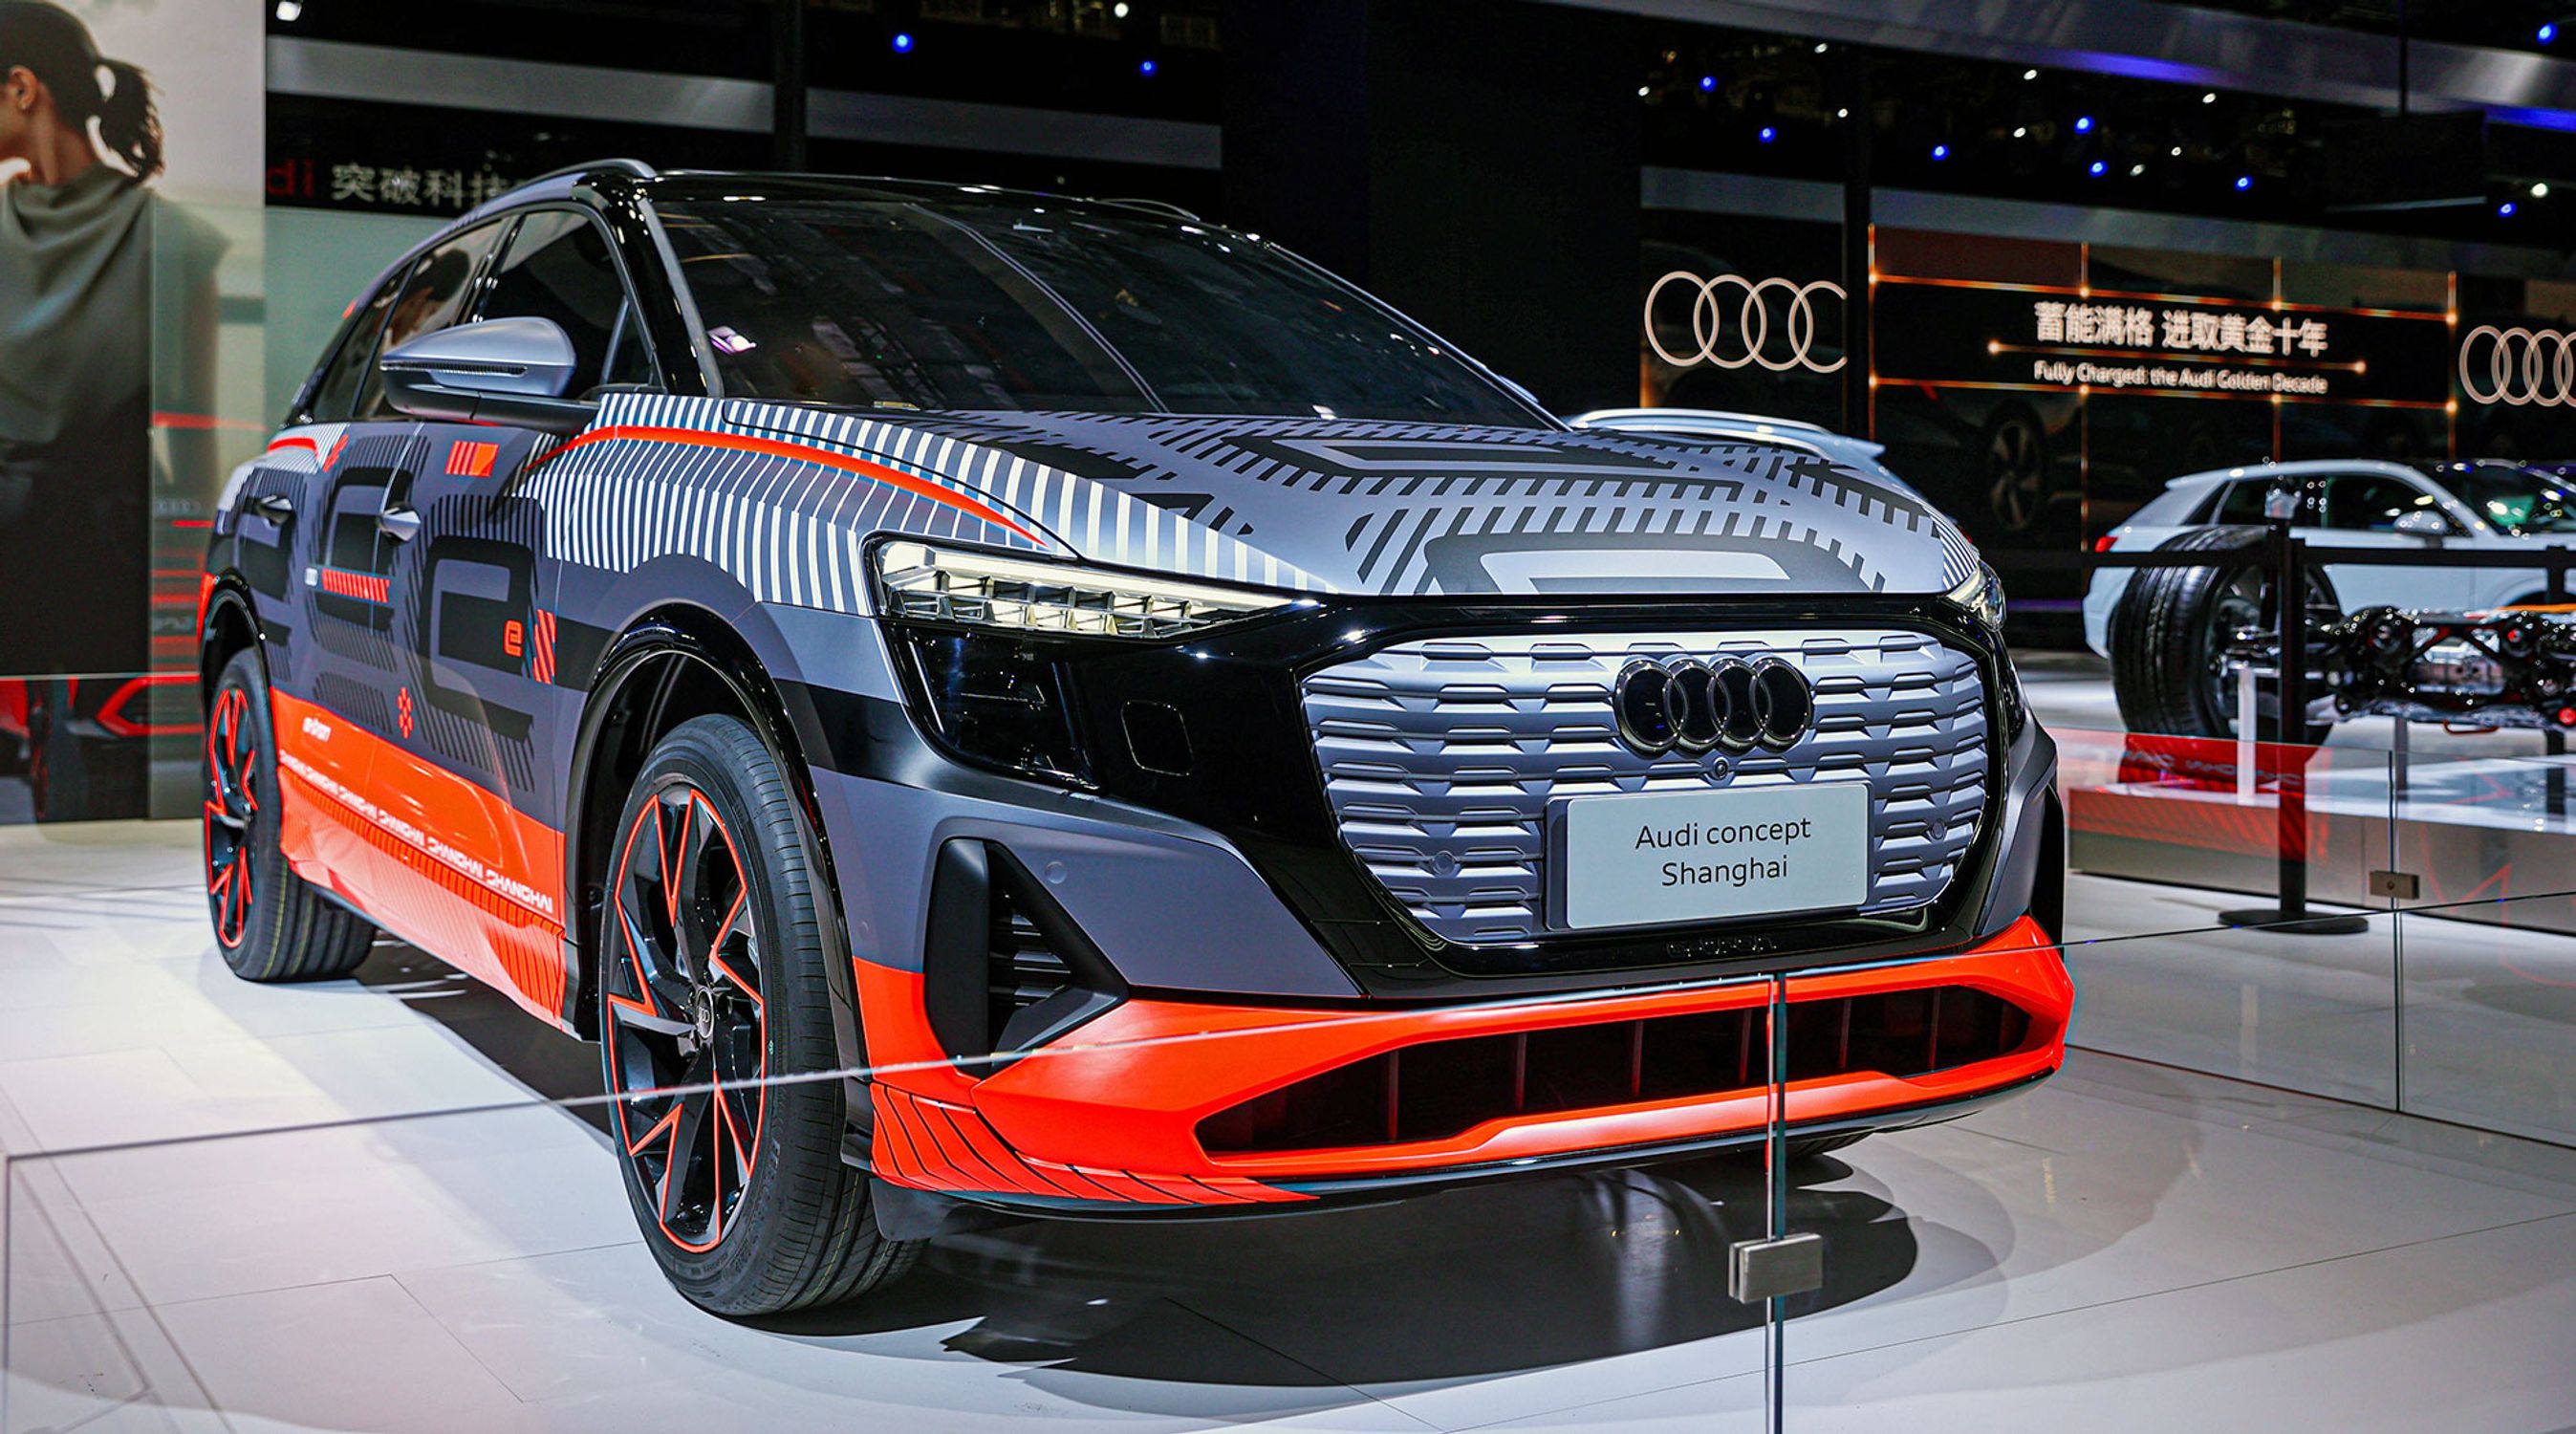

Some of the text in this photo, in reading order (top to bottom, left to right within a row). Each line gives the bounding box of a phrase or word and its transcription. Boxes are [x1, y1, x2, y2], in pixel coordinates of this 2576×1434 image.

[2033, 301, 2329, 358] 蓄能满格 进取黄金十年
[2033, 359, 2076, 386] Fully
[2151, 365, 2180, 386] the
[2179, 367, 2216, 388] Audi
[2217, 369, 2271, 391] Golden
[2272, 372, 2329, 394] Decade
[1635, 817, 1812, 850] Audi concept
[1661, 854, 1788, 888] Shanghai
[486, 868, 553, 914] SHANGHAI
